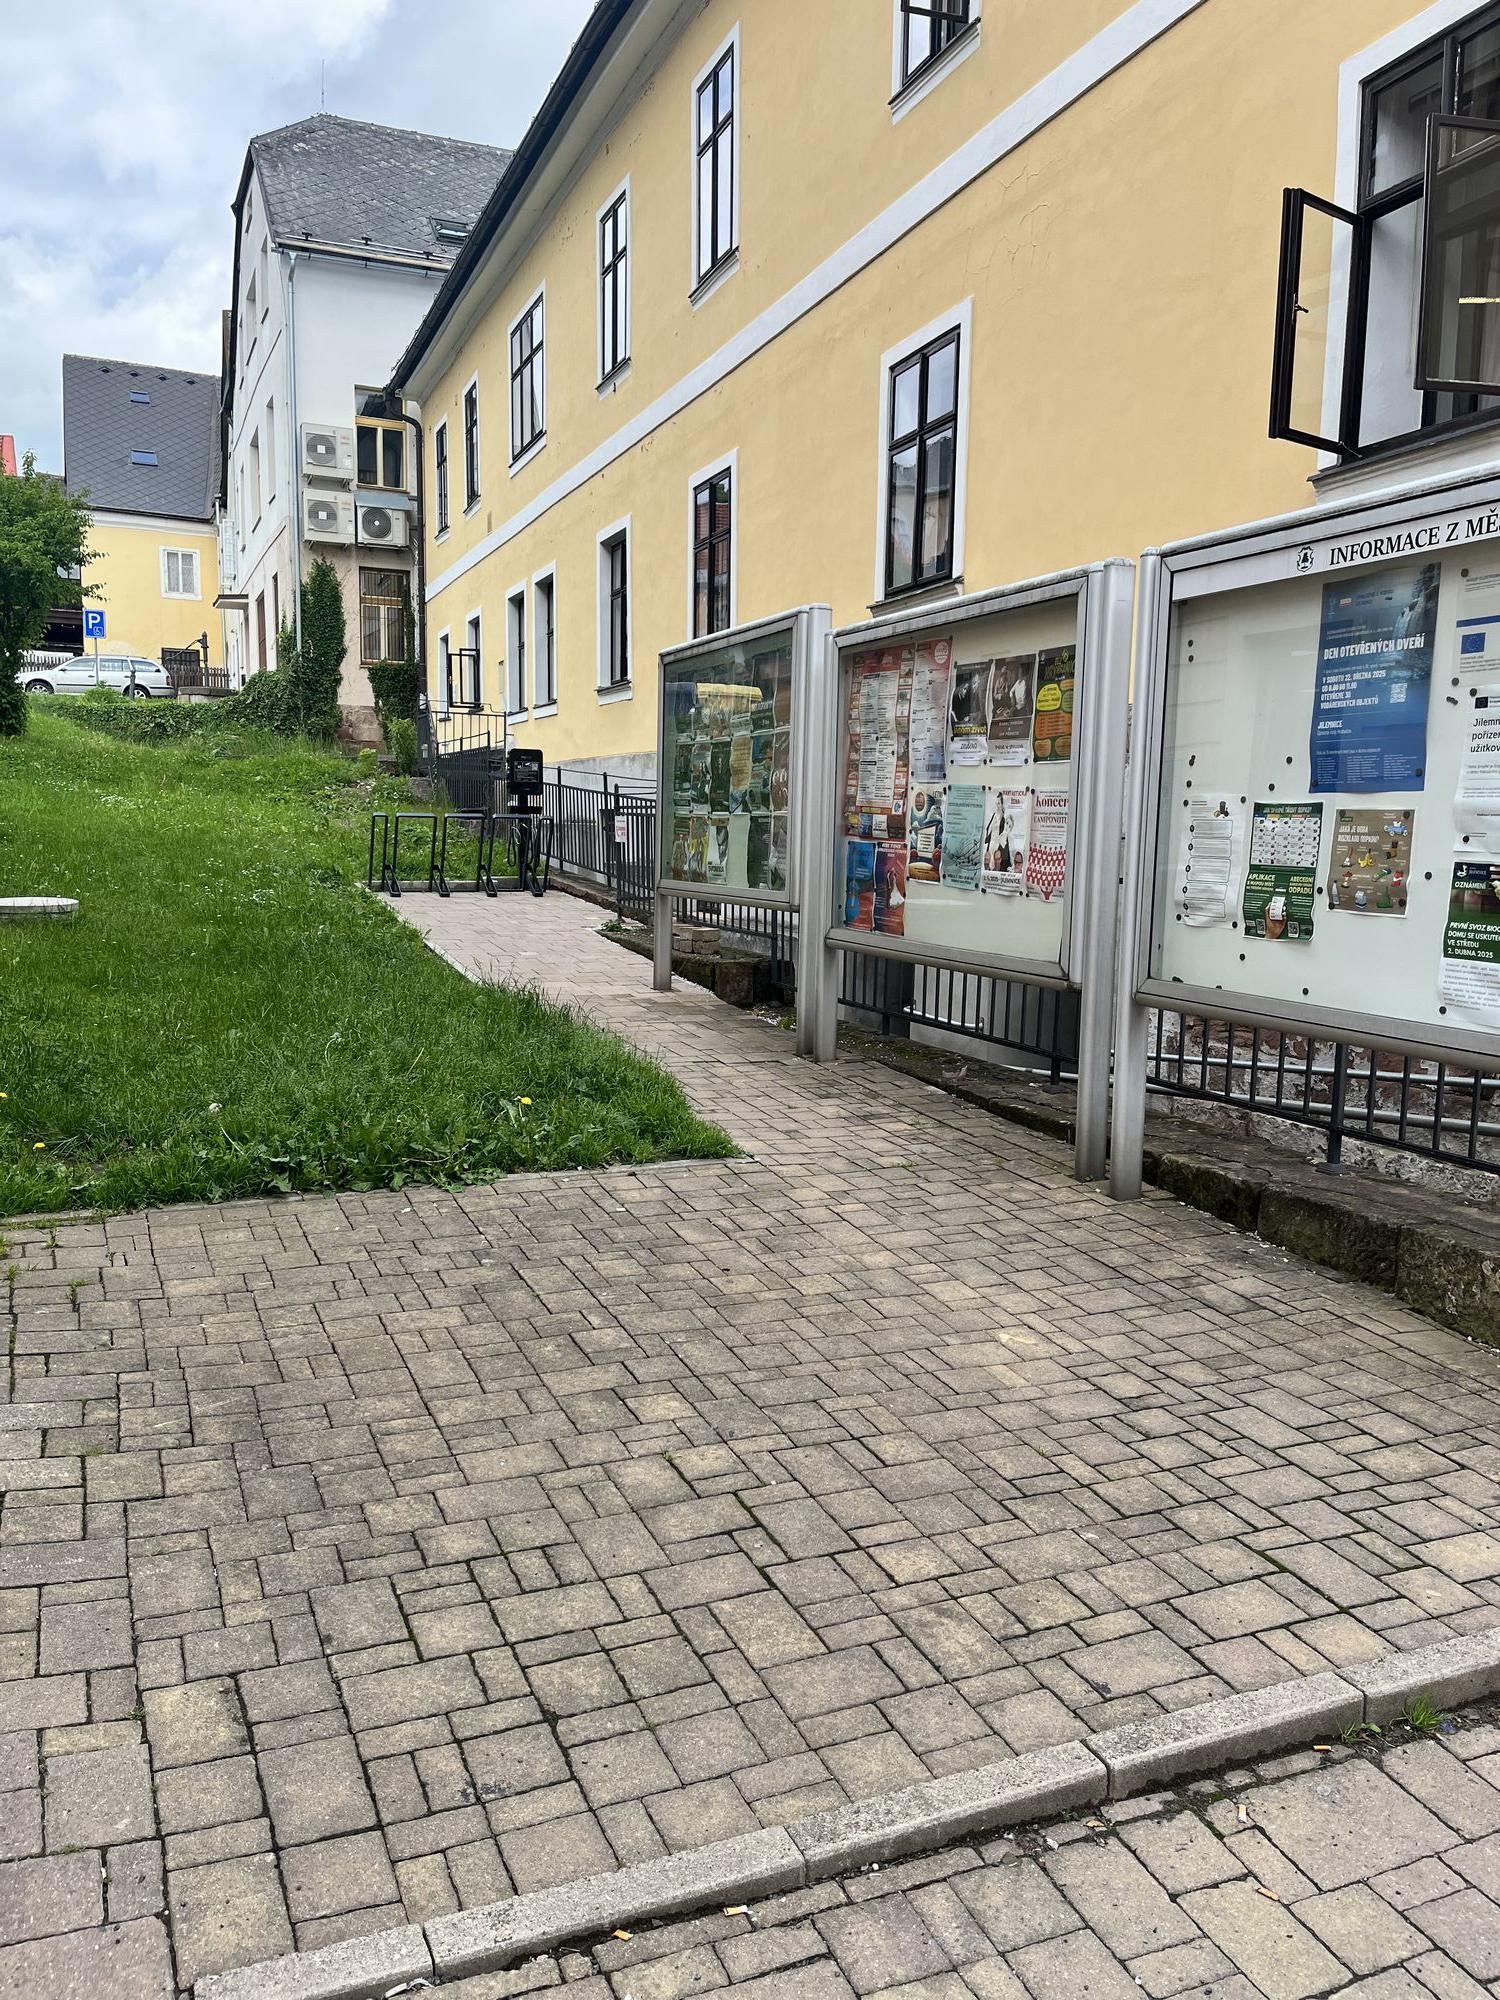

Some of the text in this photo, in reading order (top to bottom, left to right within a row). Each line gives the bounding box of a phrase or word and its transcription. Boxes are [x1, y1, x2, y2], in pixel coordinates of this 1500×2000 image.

[1329, 506, 1500, 566] INFORMACE Z MĚ
[88, 612, 101, 629] P
[1323, 632, 1426, 660] DEN OTEVŘENÝCH DVEŘÍ
[1317, 719, 1343, 729] JILEMNICE
[1247, 873, 1276, 881] APLIKACE
[1454, 880, 1487, 889] OZNÁMENÍ
[1288, 886, 1313, 895] ODPADU
[1449, 921, 1469, 930] PRVNÍ
[1468, 923, 1487, 931] SVOZ
[1447, 930, 1467, 938] DOMU
[1447, 938, 1480, 948] VE STŘEDU
[1454, 948, 1477, 957] DUBNA
[1477, 950, 1494, 959] 2025
